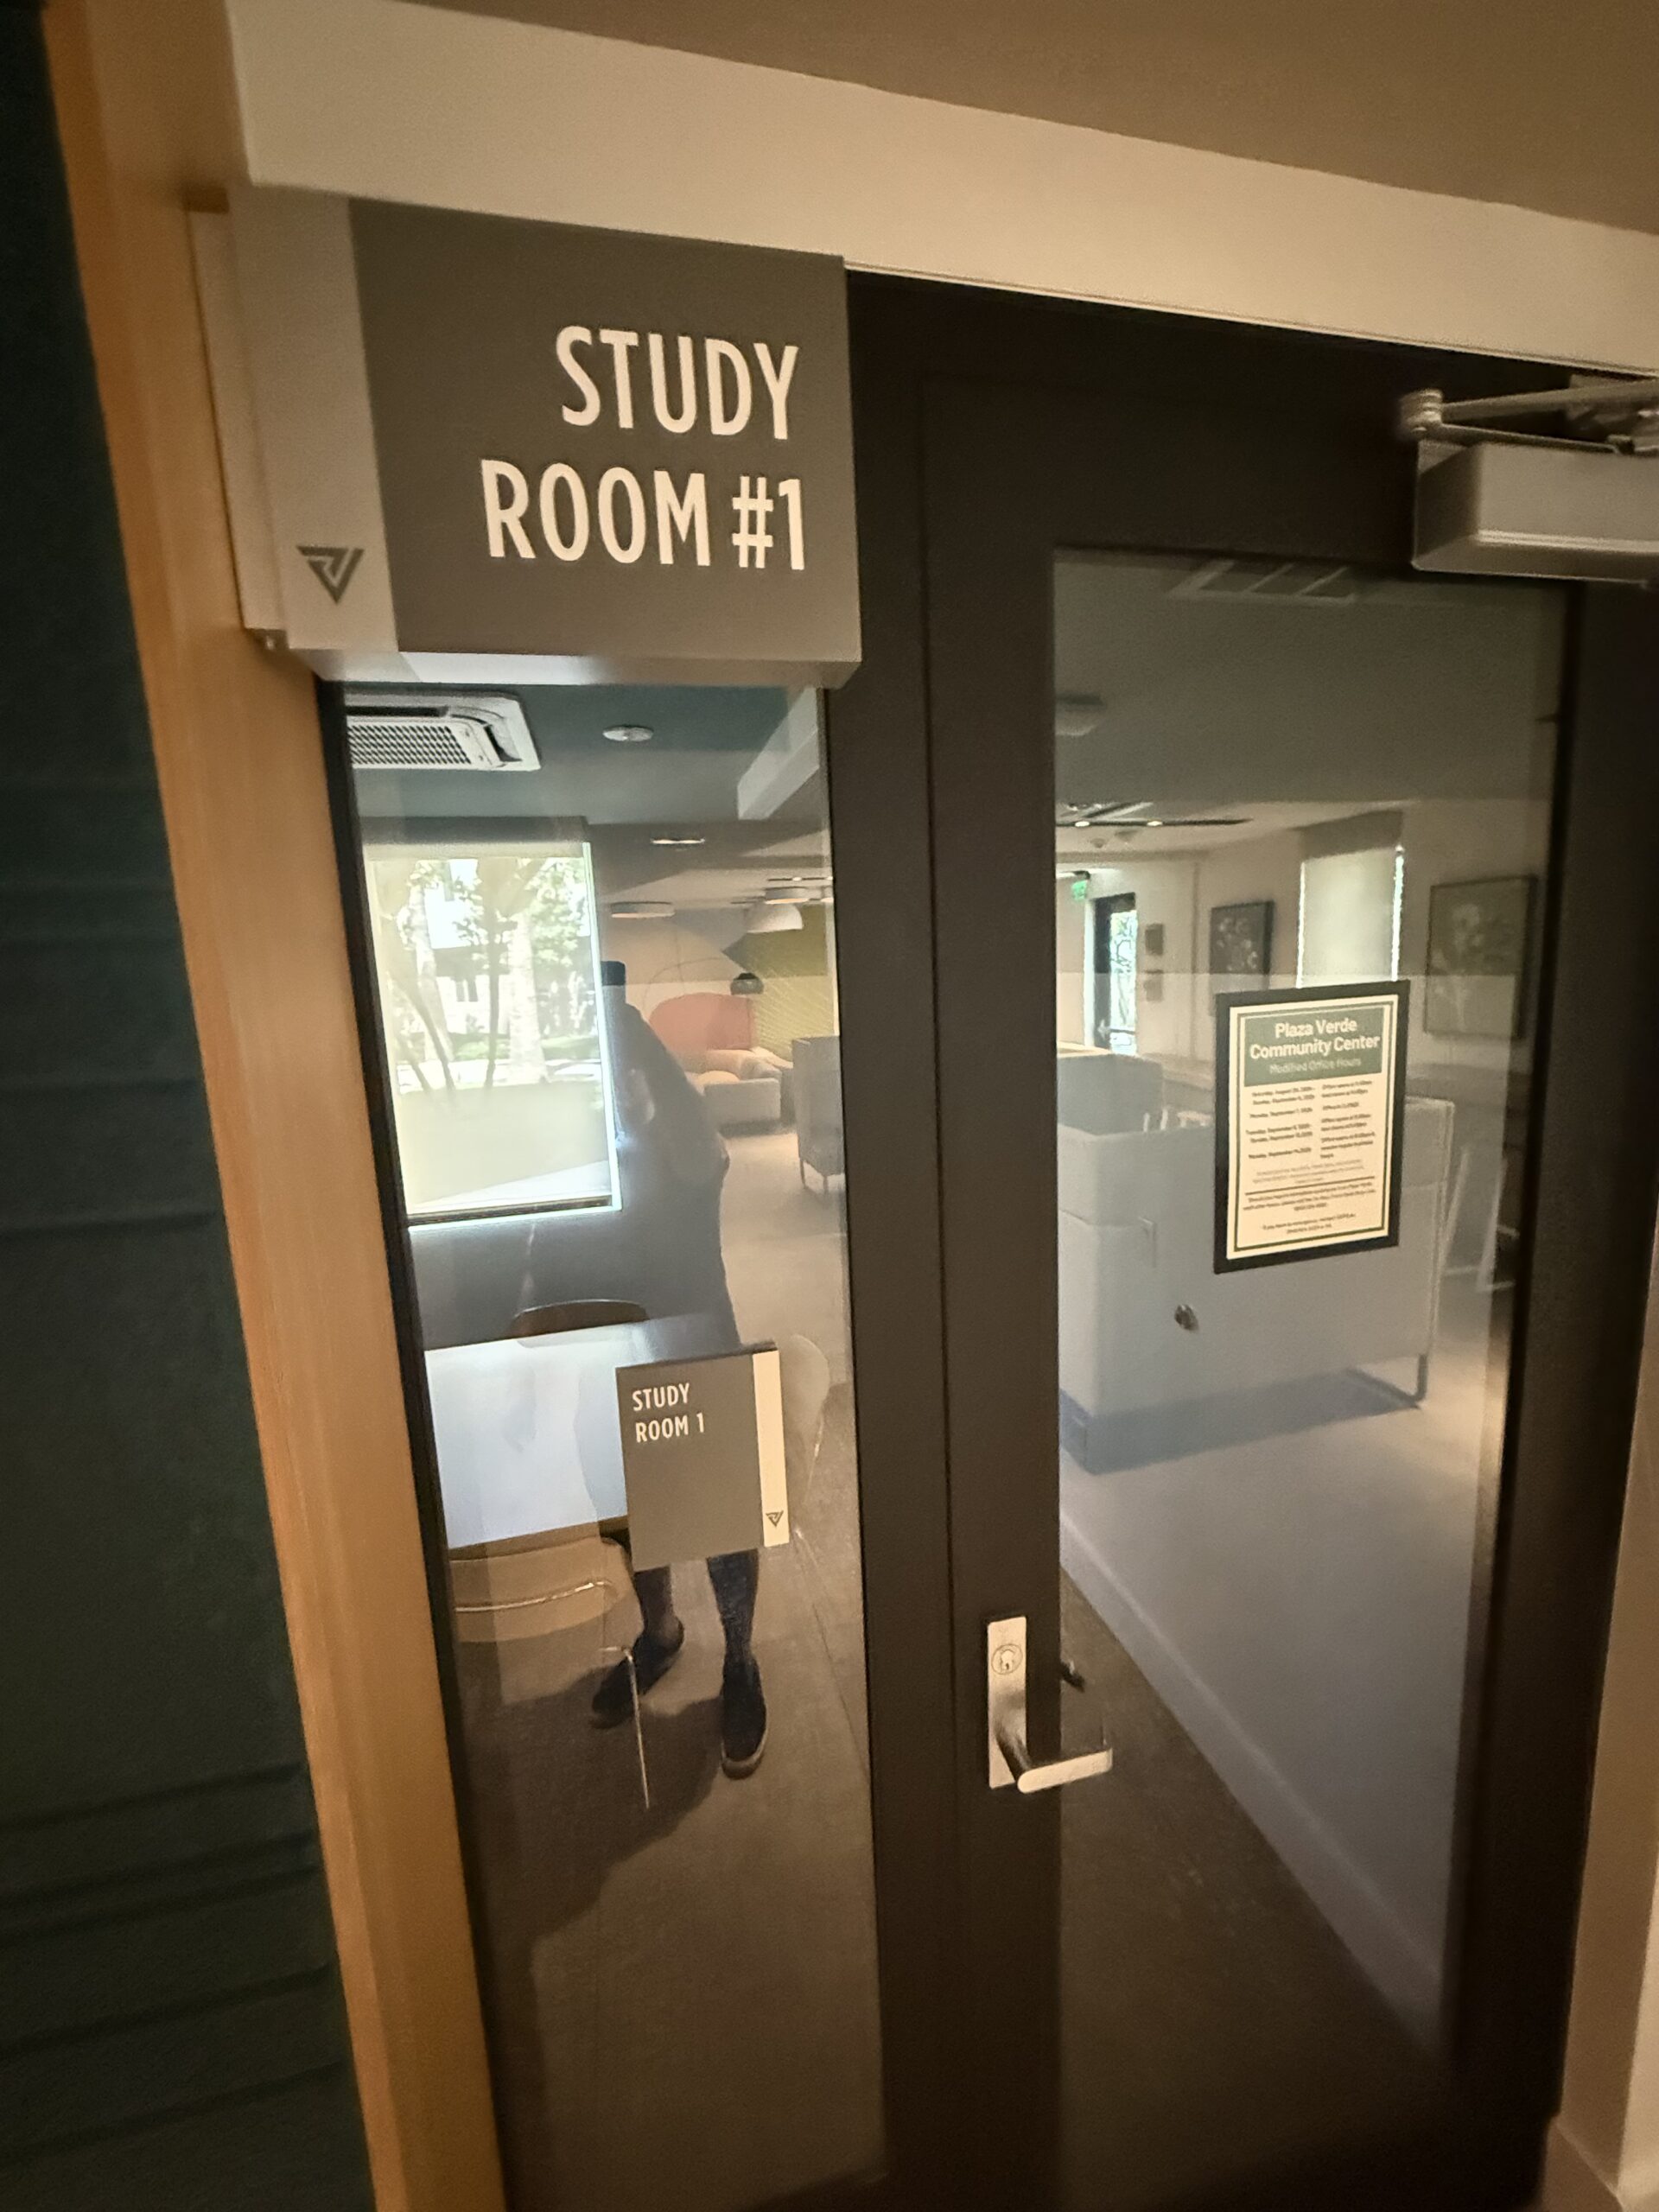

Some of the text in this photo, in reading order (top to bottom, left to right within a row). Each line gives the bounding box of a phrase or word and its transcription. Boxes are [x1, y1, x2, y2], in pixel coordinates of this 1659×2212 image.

[556, 326, 799, 440] STUDY
[480, 459, 805, 570] ROOM #1
[1274, 1017, 1357, 1039] Plaza Verde
[1250, 1035, 1381, 1059] Community Center
[632, 1382, 690, 1412] STUDY
[635, 1413, 705, 1443] ROOM 1
